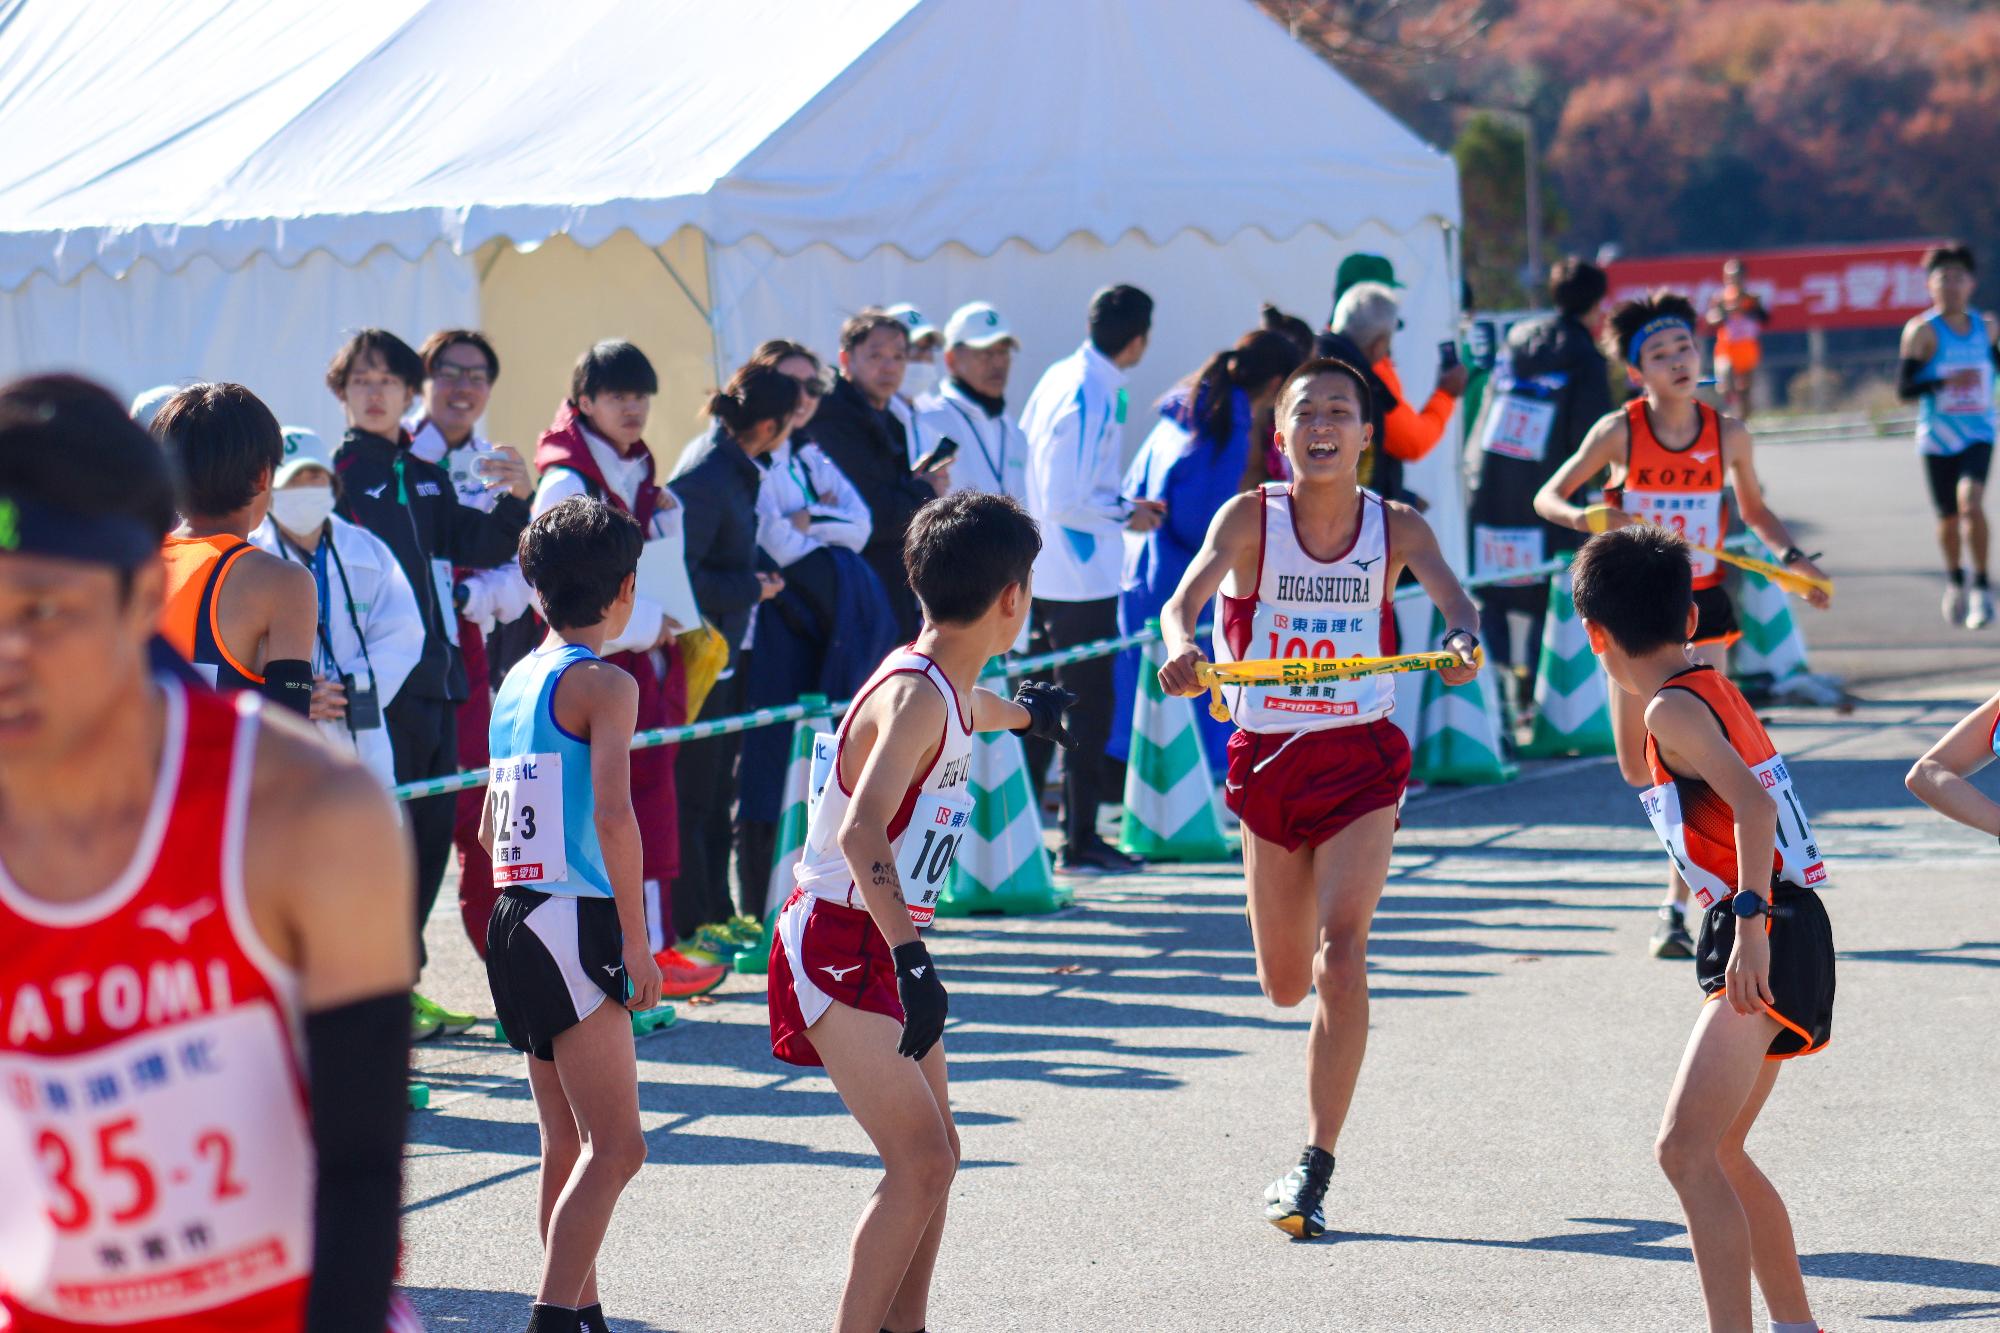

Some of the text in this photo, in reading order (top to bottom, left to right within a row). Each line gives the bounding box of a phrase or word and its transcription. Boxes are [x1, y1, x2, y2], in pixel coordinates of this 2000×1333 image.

[1637, 468, 1714, 487] KOTA
[1277, 575, 1370, 603] HIGASHIURA
[1292, 617, 1363, 633] 東海理化
[1289, 685, 1336, 699] 東浦町
[496, 846, 521, 862] 西市
[910, 829, 963, 884] 10
[0, 957, 234, 1047] ATOMI
[36, 1116, 247, 1234] 35-2
